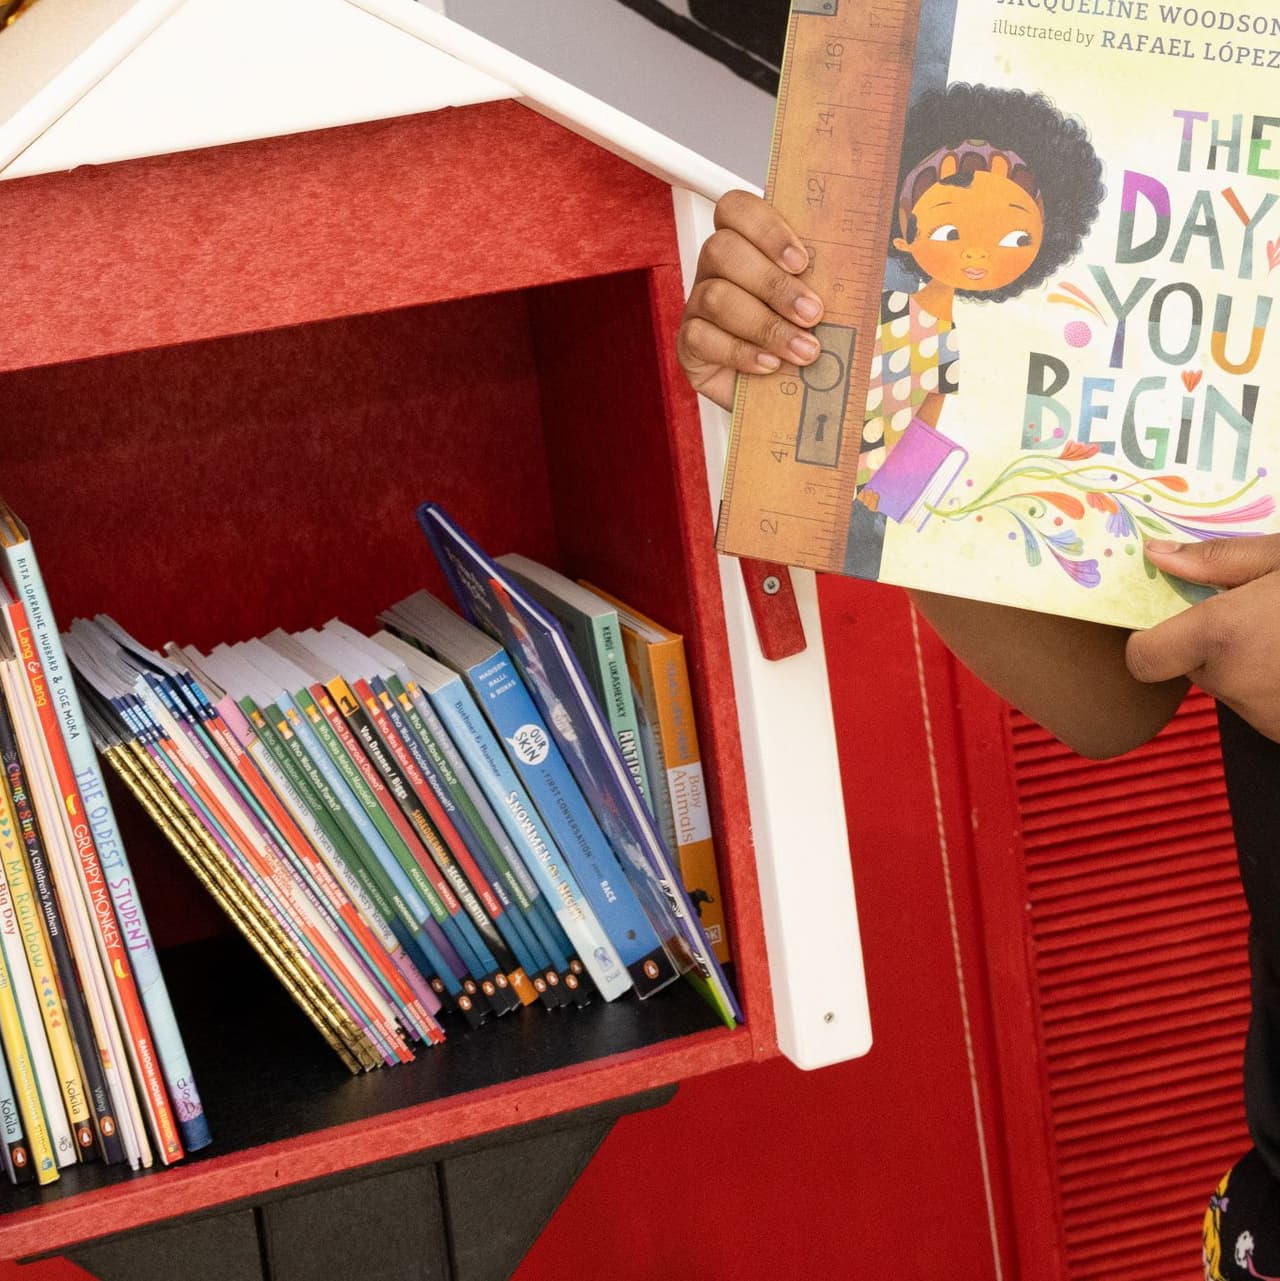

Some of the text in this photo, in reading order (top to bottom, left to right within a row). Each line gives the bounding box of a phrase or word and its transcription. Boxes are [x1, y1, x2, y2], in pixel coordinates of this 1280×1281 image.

[992, 19, 1072, 43] illustrated
[1075, 28, 1095, 47] by
[1100, 30, 1195, 58] RAFAEL
[1115, 170, 1280, 280] DAY
[1087, 264, 1273, 375] YOU
[16, 557, 31, 580] RITA
[23, 583, 45, 629] LORRAINE
[14, 627, 50, 707] Lang & Lang
[52, 675, 62, 684] &
[359, 725, 374, 743] Van
[368, 740, 393, 773] Draanen
[389, 776, 409, 800] Biggs
[516, 731, 540, 762] SKIN
[530, 728, 547, 751] OUR
[4, 762, 29, 809] Change
[672, 770, 694, 843] Animals
[688, 774, 702, 808] Baby
[16, 809, 38, 846] Sings
[504, 790, 553, 864] SNOWMEN
[74, 765, 151, 954] THE OLDEST STUDENT
[72, 823, 121, 951] GRUMPY MONKEY
[446, 864, 468, 893] SECRET
[463, 891, 490, 928] IDENTITY
[598, 879, 617, 904] RACE
[2, 858, 48, 969] My Rainbow
[42, 900, 60, 936] Anthem
[137, 1038, 156, 1077] RANDOM
[148, 1077, 164, 1107] HOUSE
[64, 1078, 83, 1115] Kokila
[91, 1086, 107, 1113] Viking
